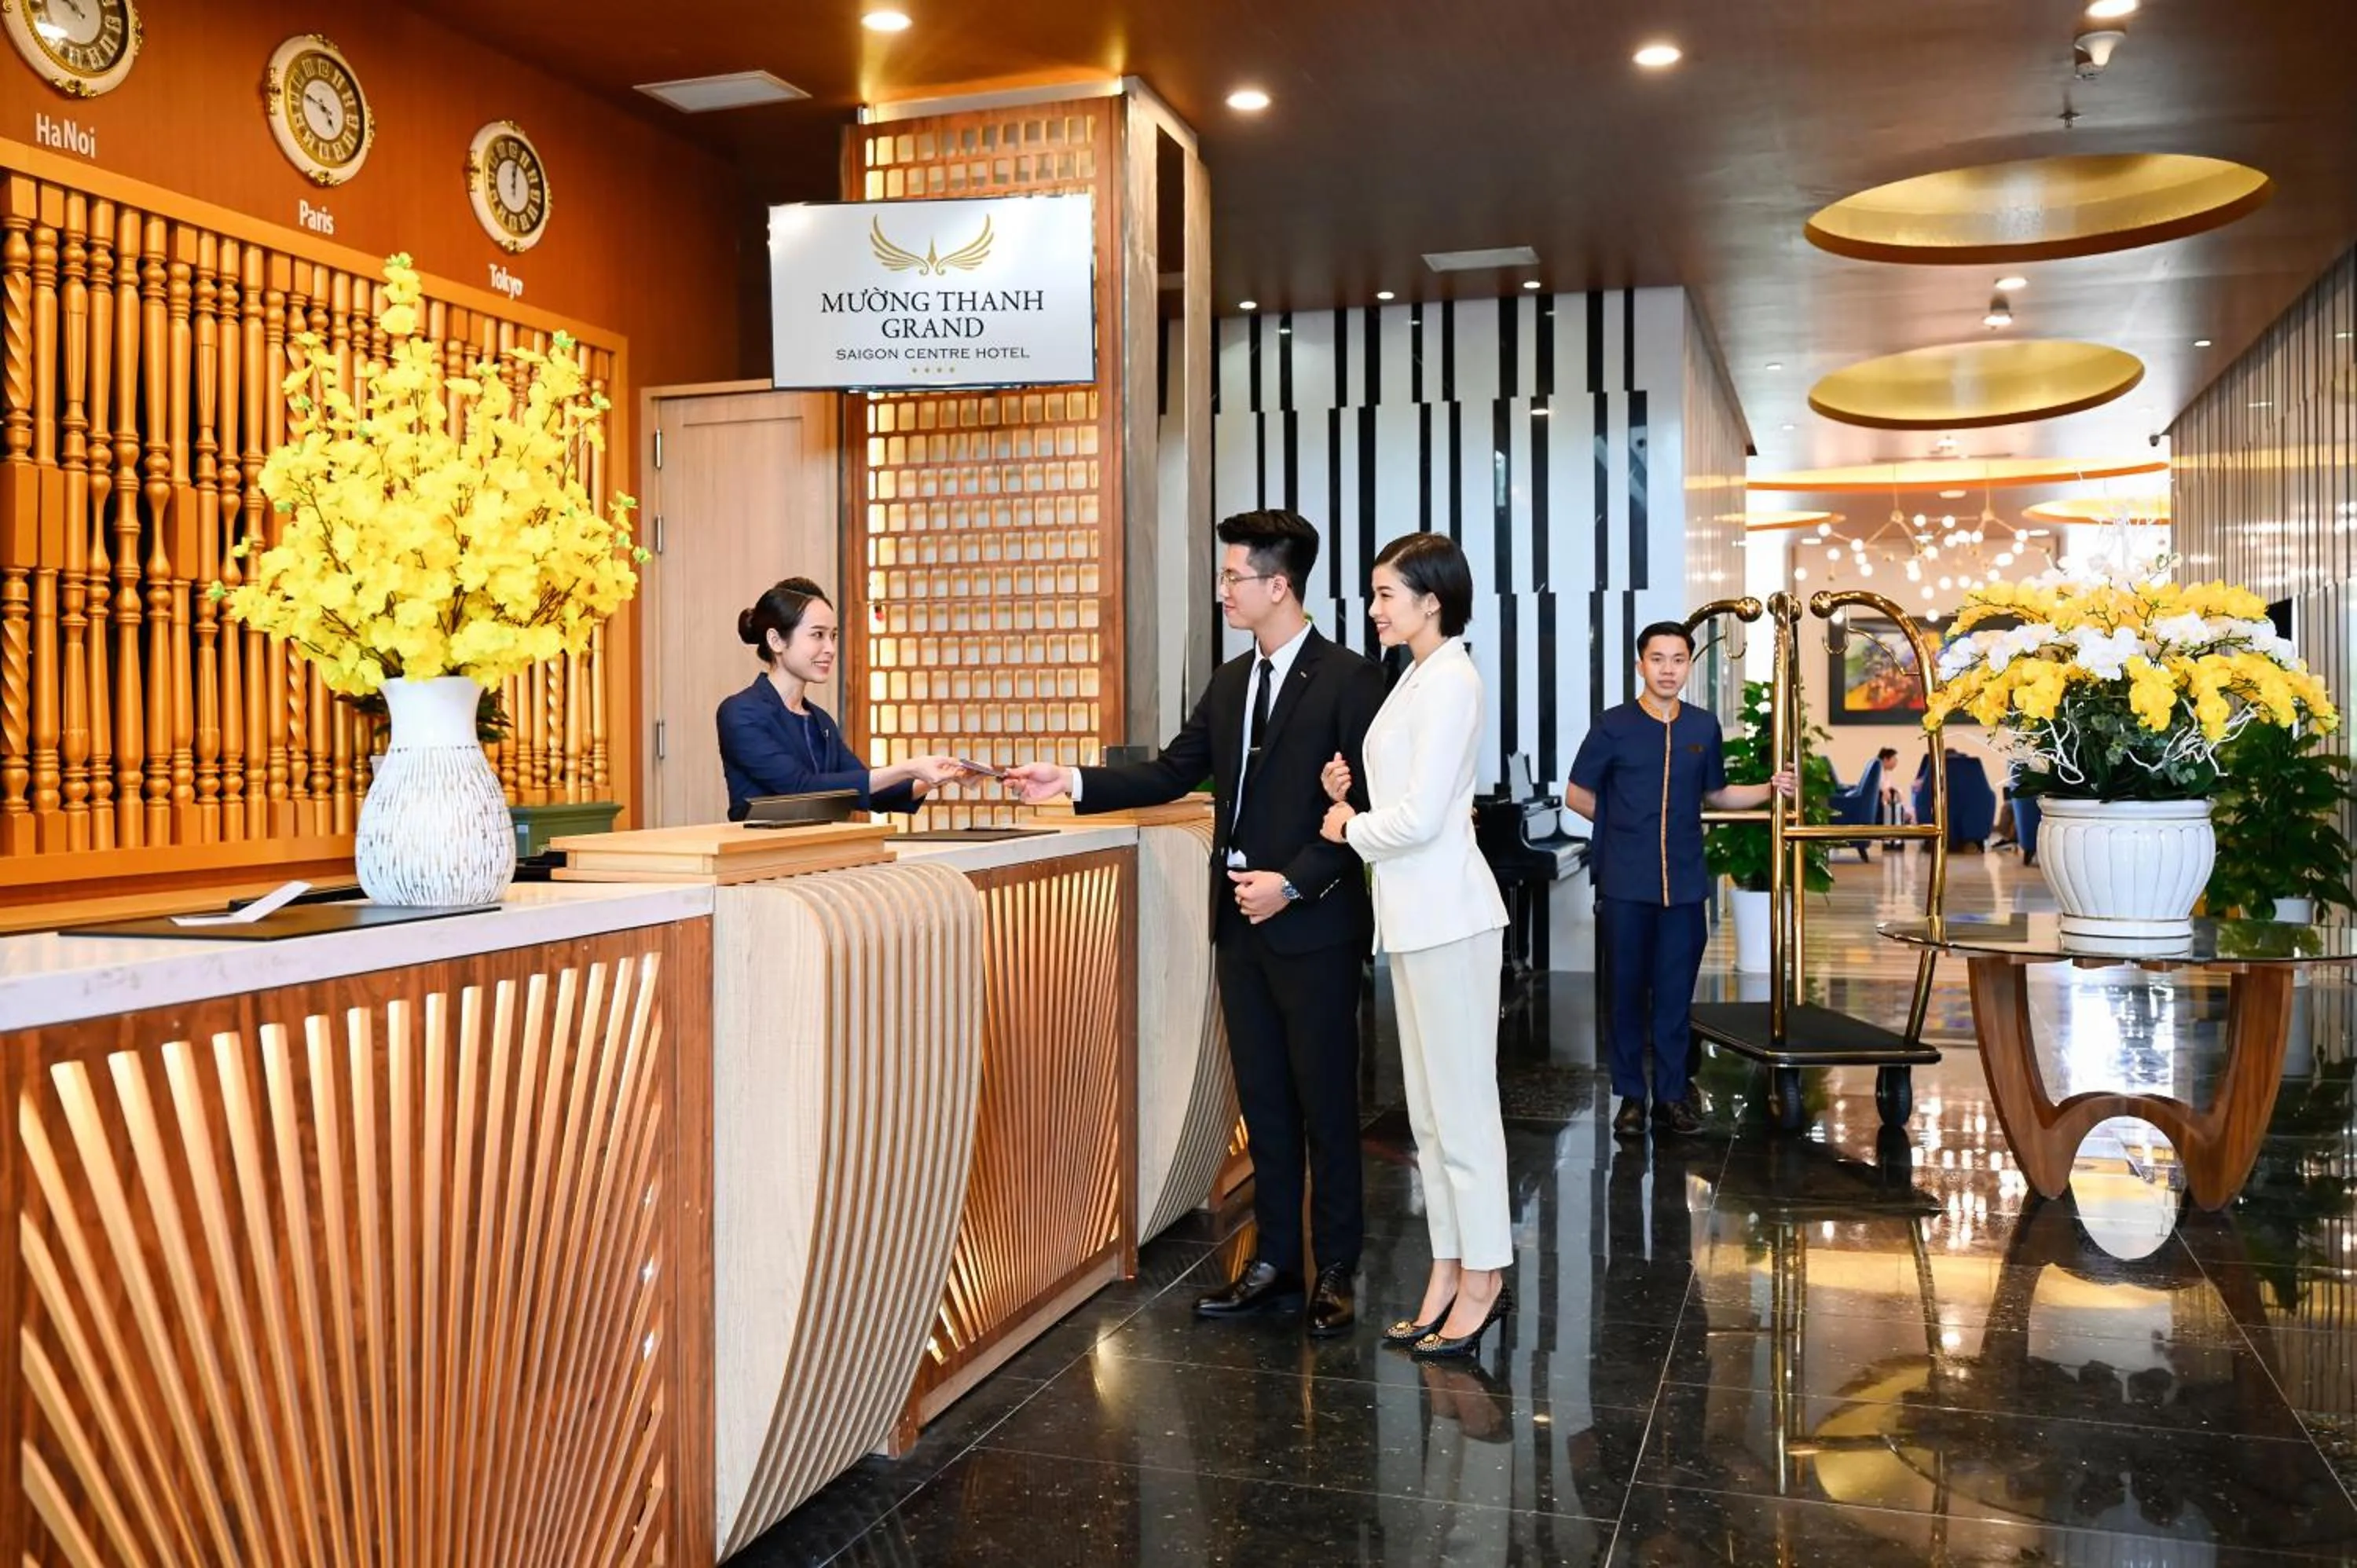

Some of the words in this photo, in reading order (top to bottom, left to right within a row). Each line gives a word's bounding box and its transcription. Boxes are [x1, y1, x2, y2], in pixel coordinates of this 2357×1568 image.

[36, 112, 96, 157] HaNoi
[300, 200, 334, 235] Paris
[489, 263, 523, 299] Tokyo
[821, 288, 930, 313] MƯỜNG
[937, 291, 1045, 312] THANH
[882, 317, 984, 339] GRAND
[835, 348, 899, 361] SAIGON
[904, 347, 971, 360] CENTRE
[976, 346, 1031, 359] HOTEL
